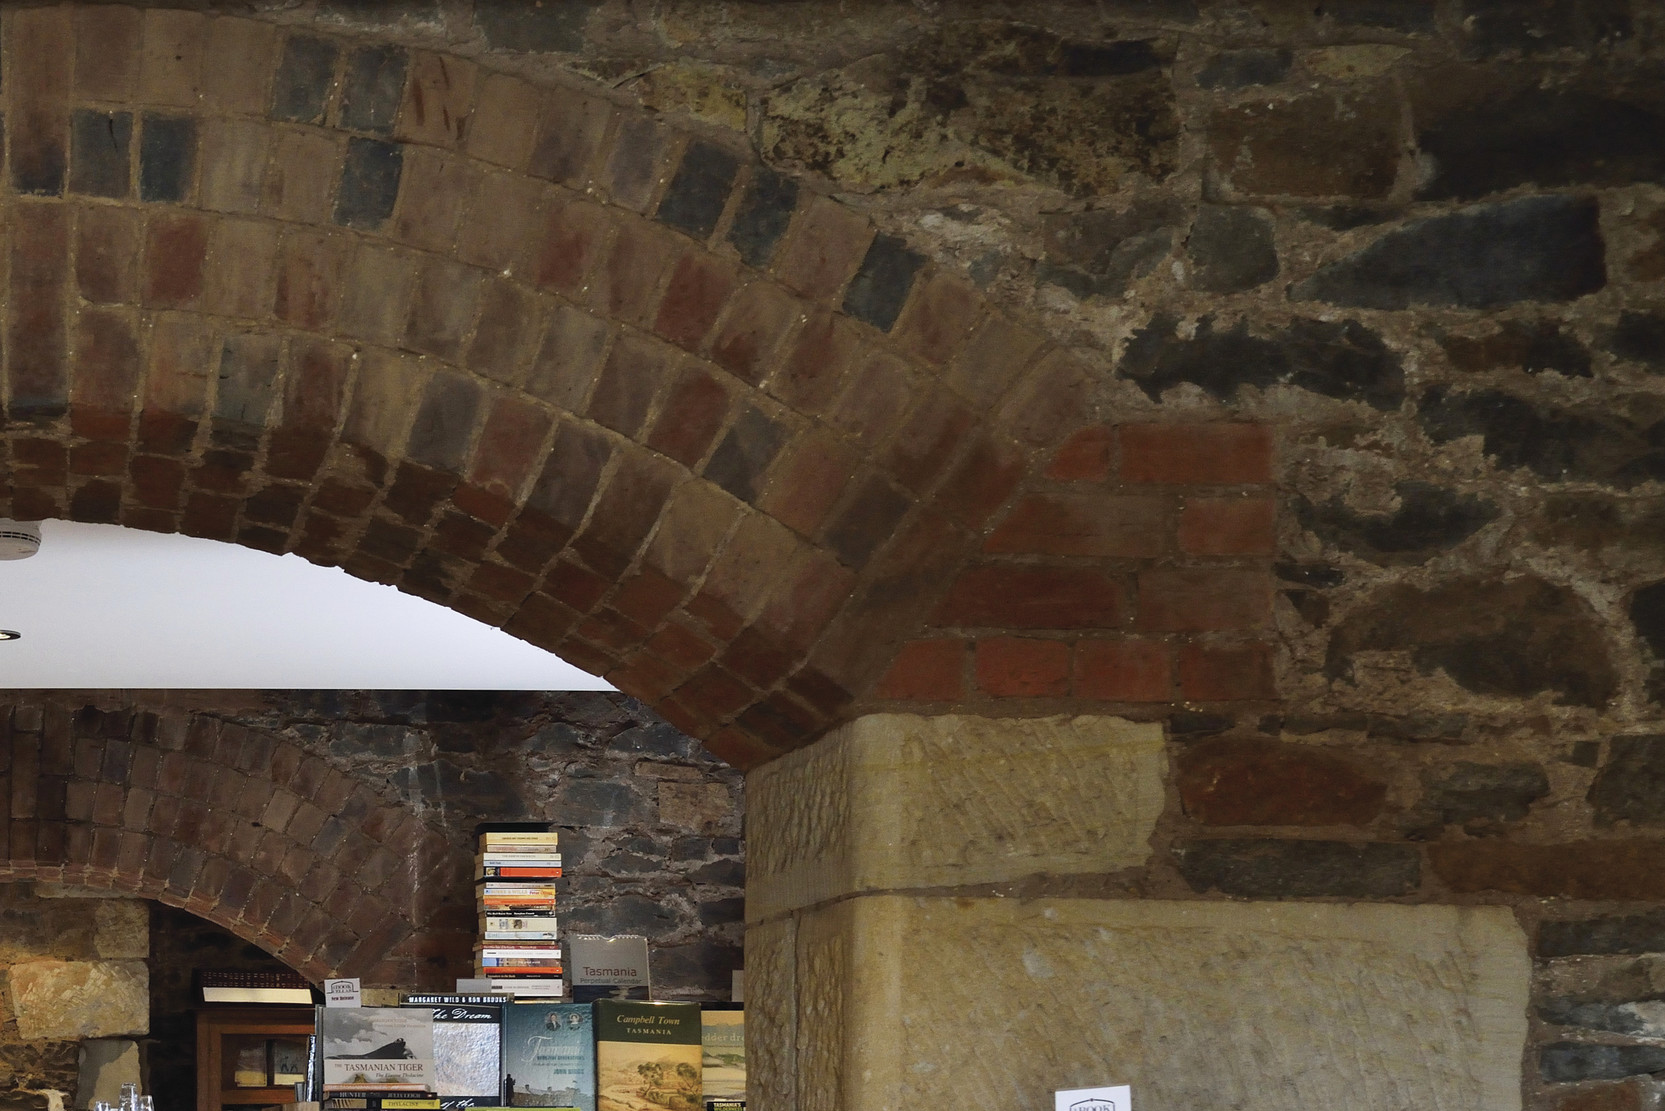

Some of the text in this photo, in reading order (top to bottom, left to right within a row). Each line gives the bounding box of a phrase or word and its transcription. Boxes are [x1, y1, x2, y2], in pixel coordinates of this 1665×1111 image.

[583, 966, 637, 977] Tasmania
[616, 1014, 680, 1026] Campbell Town
[626, 1028, 672, 1036] TASMANIA
[398, 1063, 424, 1071] TIGER
